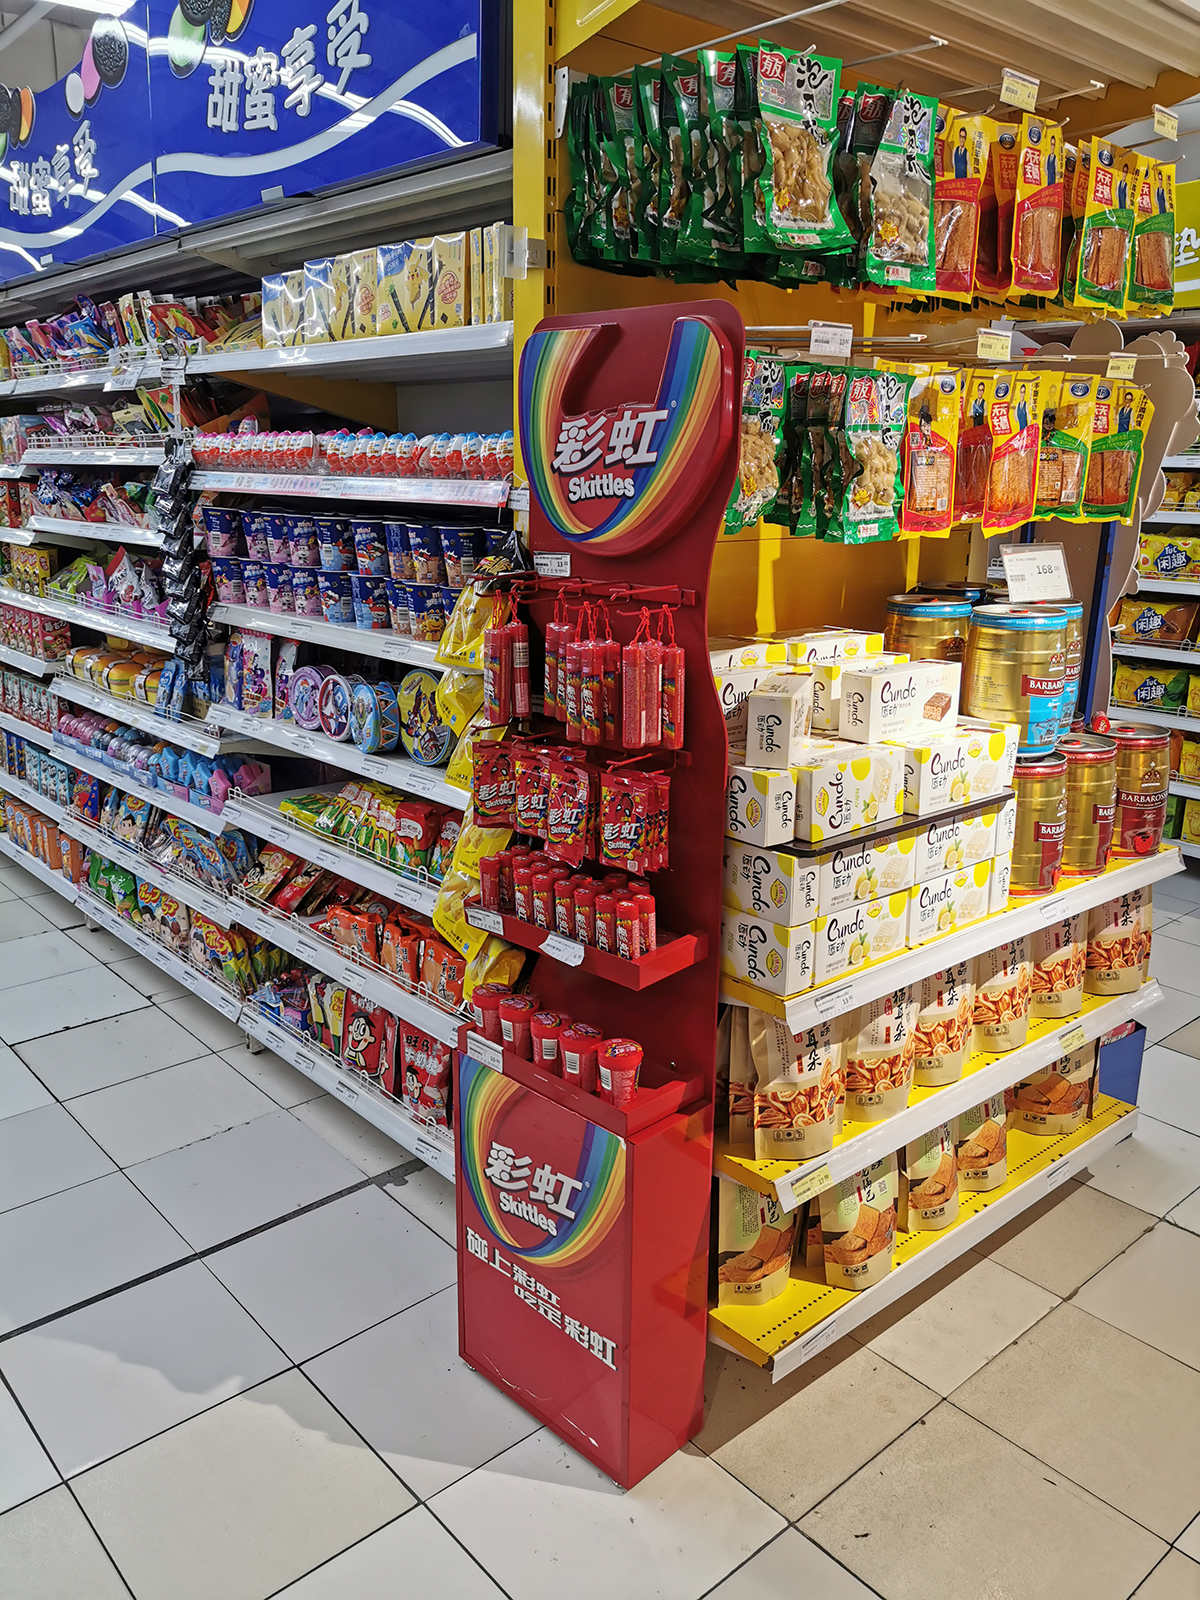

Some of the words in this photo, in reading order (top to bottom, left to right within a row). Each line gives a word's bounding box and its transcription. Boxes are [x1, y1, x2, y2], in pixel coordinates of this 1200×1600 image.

[207, 0, 372, 133] 甜蜜享受
[9, 120, 99, 217] 甜蜜享受
[551, 409, 668, 473] 彩虹
[568, 473, 635, 501] Skittles
[1157, 553, 1187, 571] 闲趣
[1135, 614, 1162, 632] 闲趣
[880, 676, 917, 704] Cundo
[1137, 683, 1165, 701] 闲趣
[765, 714, 783, 753] Cundo
[931, 747, 966, 776] Cundo
[517, 793, 548, 811] 彩虹
[549, 808, 582, 825] 彩虹
[729, 774, 748, 832] Cundo
[781, 790, 793, 828] Cundo
[828, 771, 844, 829] Cundo
[604, 822, 640, 840] 彩虹
[927, 818, 960, 846] Cundo
[832, 844, 871, 875] Cundo
[752, 855, 771, 912] Cundo
[804, 871, 816, 909] Cundo
[919, 878, 953, 909] Cundo
[827, 908, 864, 943] Cundo
[1119, 894, 1133, 927] 耳朵
[747, 925, 767, 980] Cundo
[799, 940, 811, 977] Cundo
[945, 966, 958, 1006] 耳朵
[806, 1028, 822, 1072] 耳朵
[484, 1141, 583, 1220] 彩虹
[499, 1191, 558, 1238] Skittles
[466, 1225, 561, 1309] 碰上彩虹
[514, 1284, 618, 1371] 吃定彩虹
